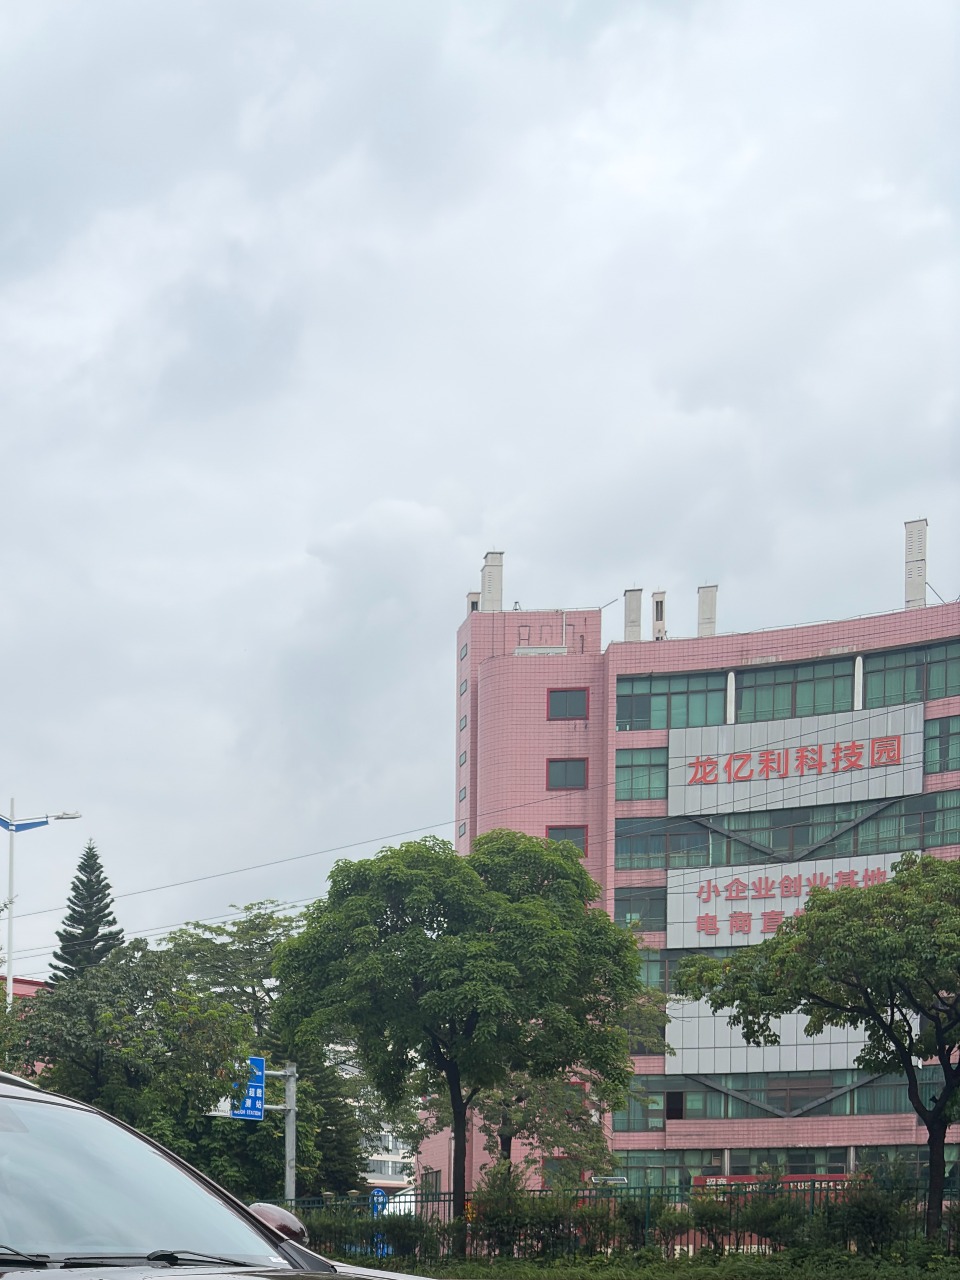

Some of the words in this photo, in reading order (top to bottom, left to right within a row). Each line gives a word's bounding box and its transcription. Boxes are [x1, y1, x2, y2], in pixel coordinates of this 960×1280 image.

[688, 735, 902, 786] 龙亿利科技园
[696, 907, 806, 936] 电商直
